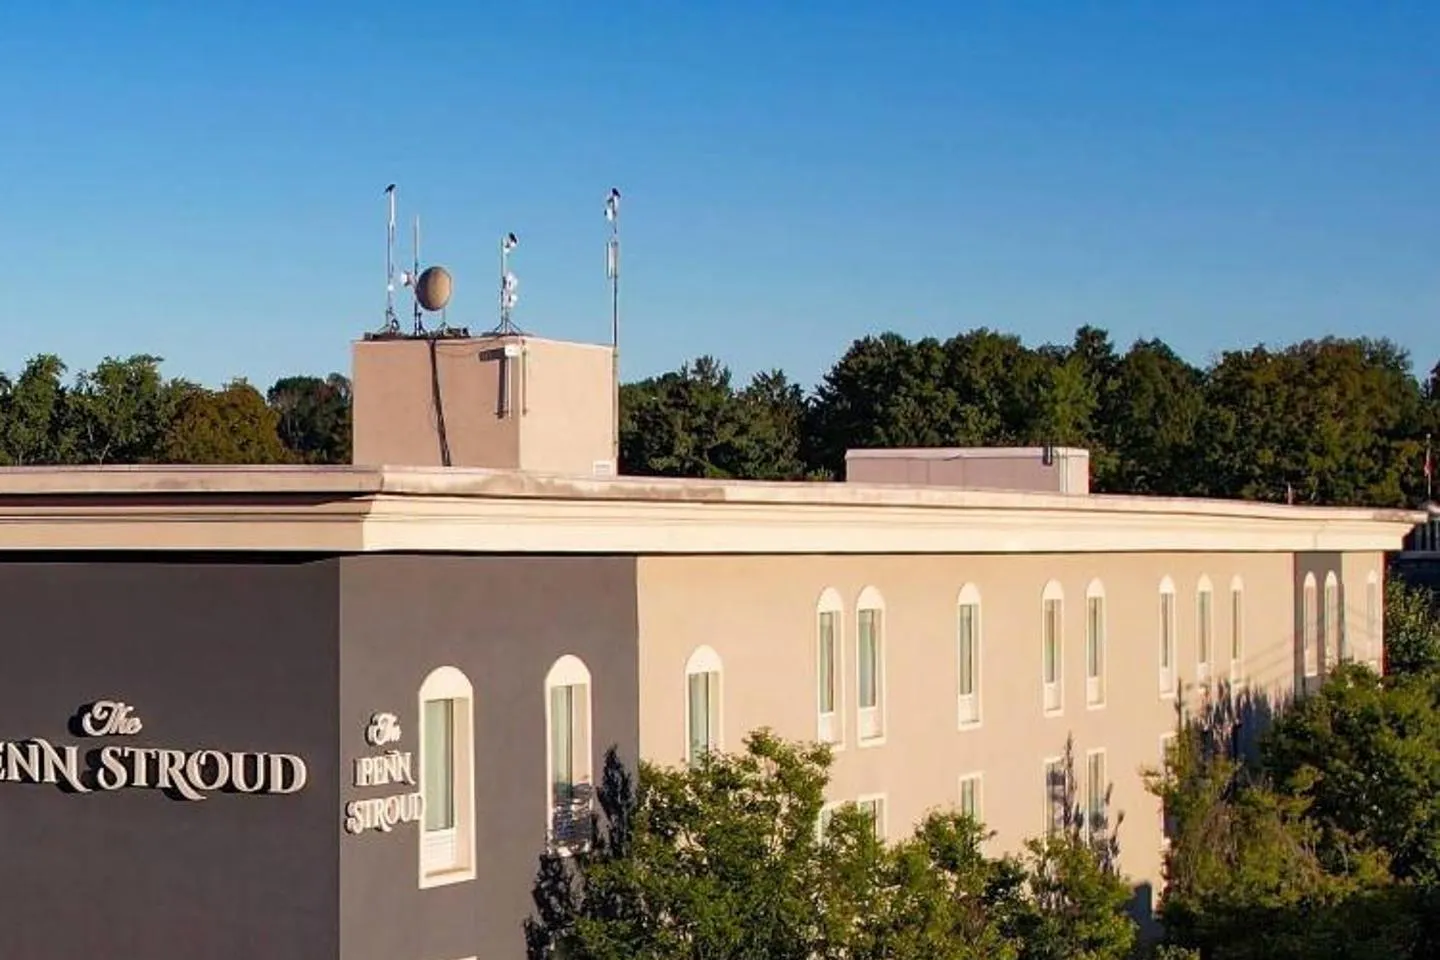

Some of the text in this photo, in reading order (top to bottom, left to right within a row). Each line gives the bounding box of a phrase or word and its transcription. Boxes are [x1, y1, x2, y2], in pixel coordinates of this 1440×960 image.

[81, 700, 143, 737] The
[96, 746, 308, 800] STROUD
[355, 750, 416, 786] PENN
[347, 792, 425, 834] STROUD
